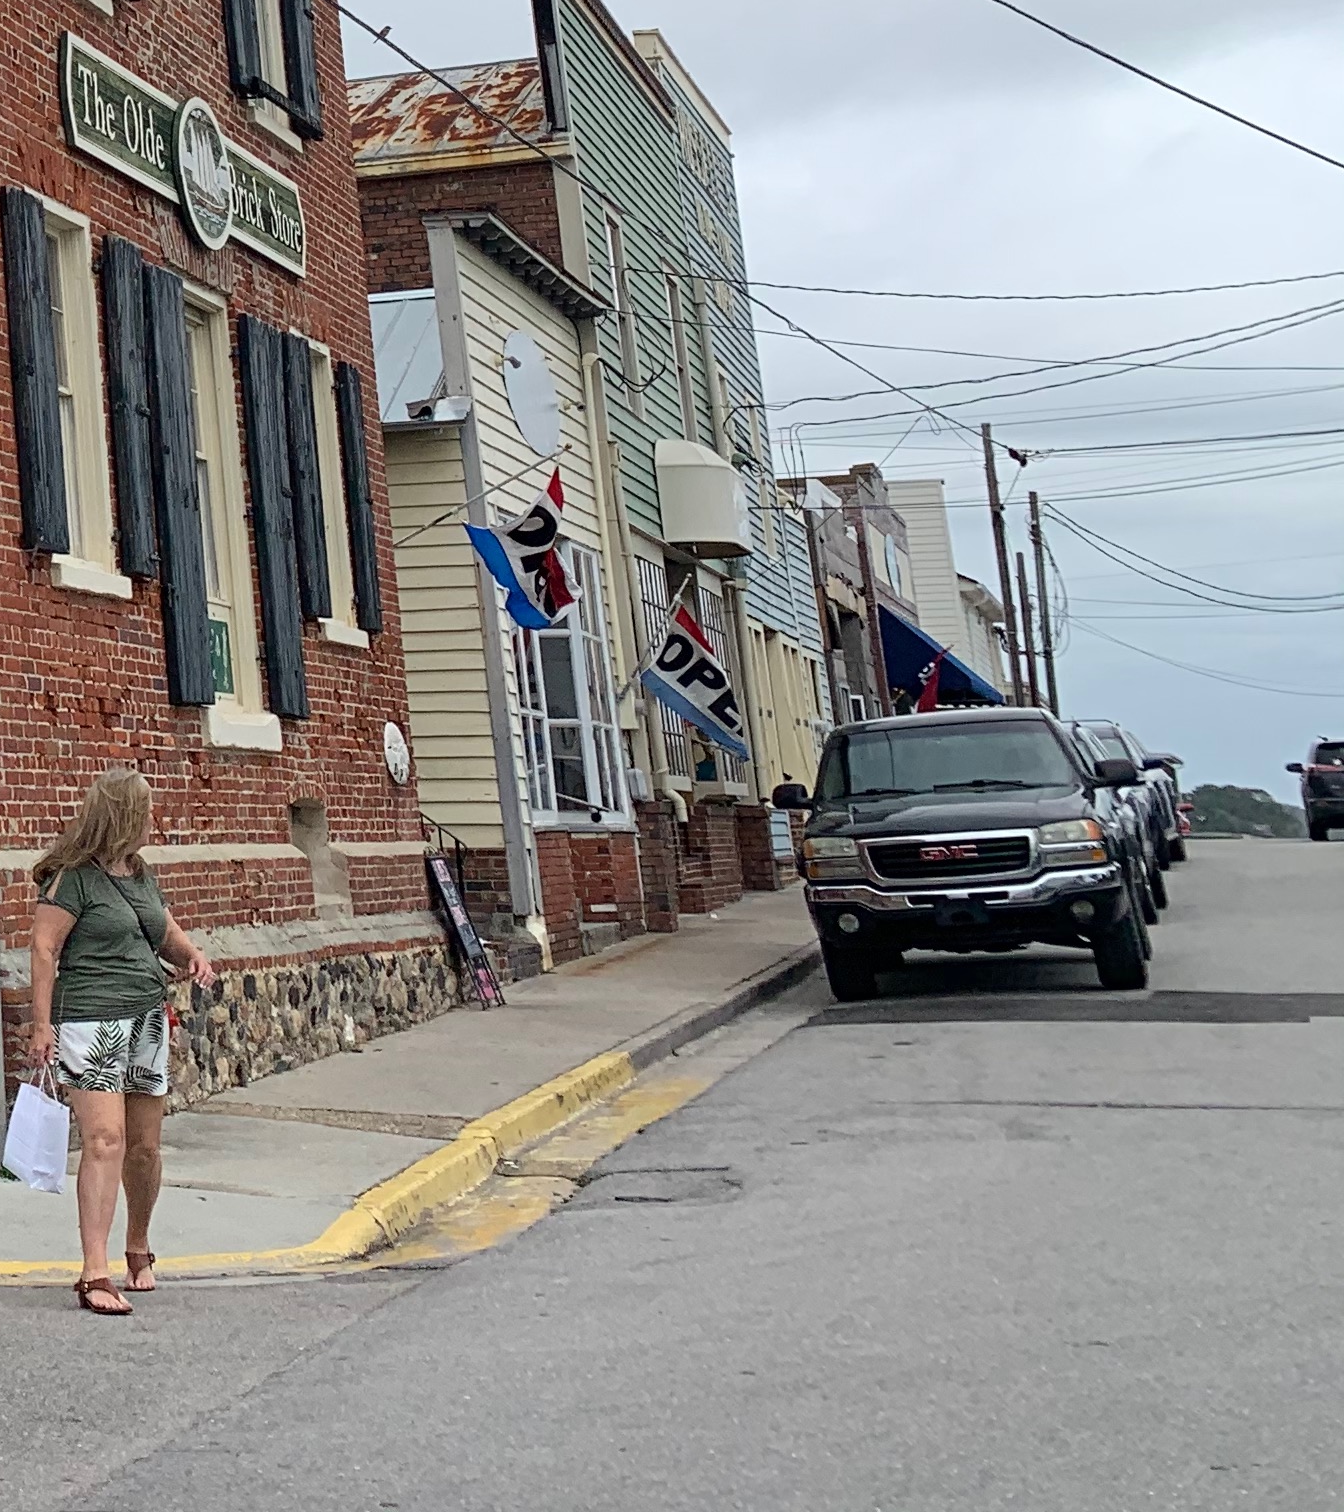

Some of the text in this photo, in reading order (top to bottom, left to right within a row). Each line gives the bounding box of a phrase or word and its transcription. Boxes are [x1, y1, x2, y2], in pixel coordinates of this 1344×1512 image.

[77, 62, 302, 254] The Olde Brick Store
[656, 633, 744, 738] OPE
[919, 844, 979, 862] GMC
